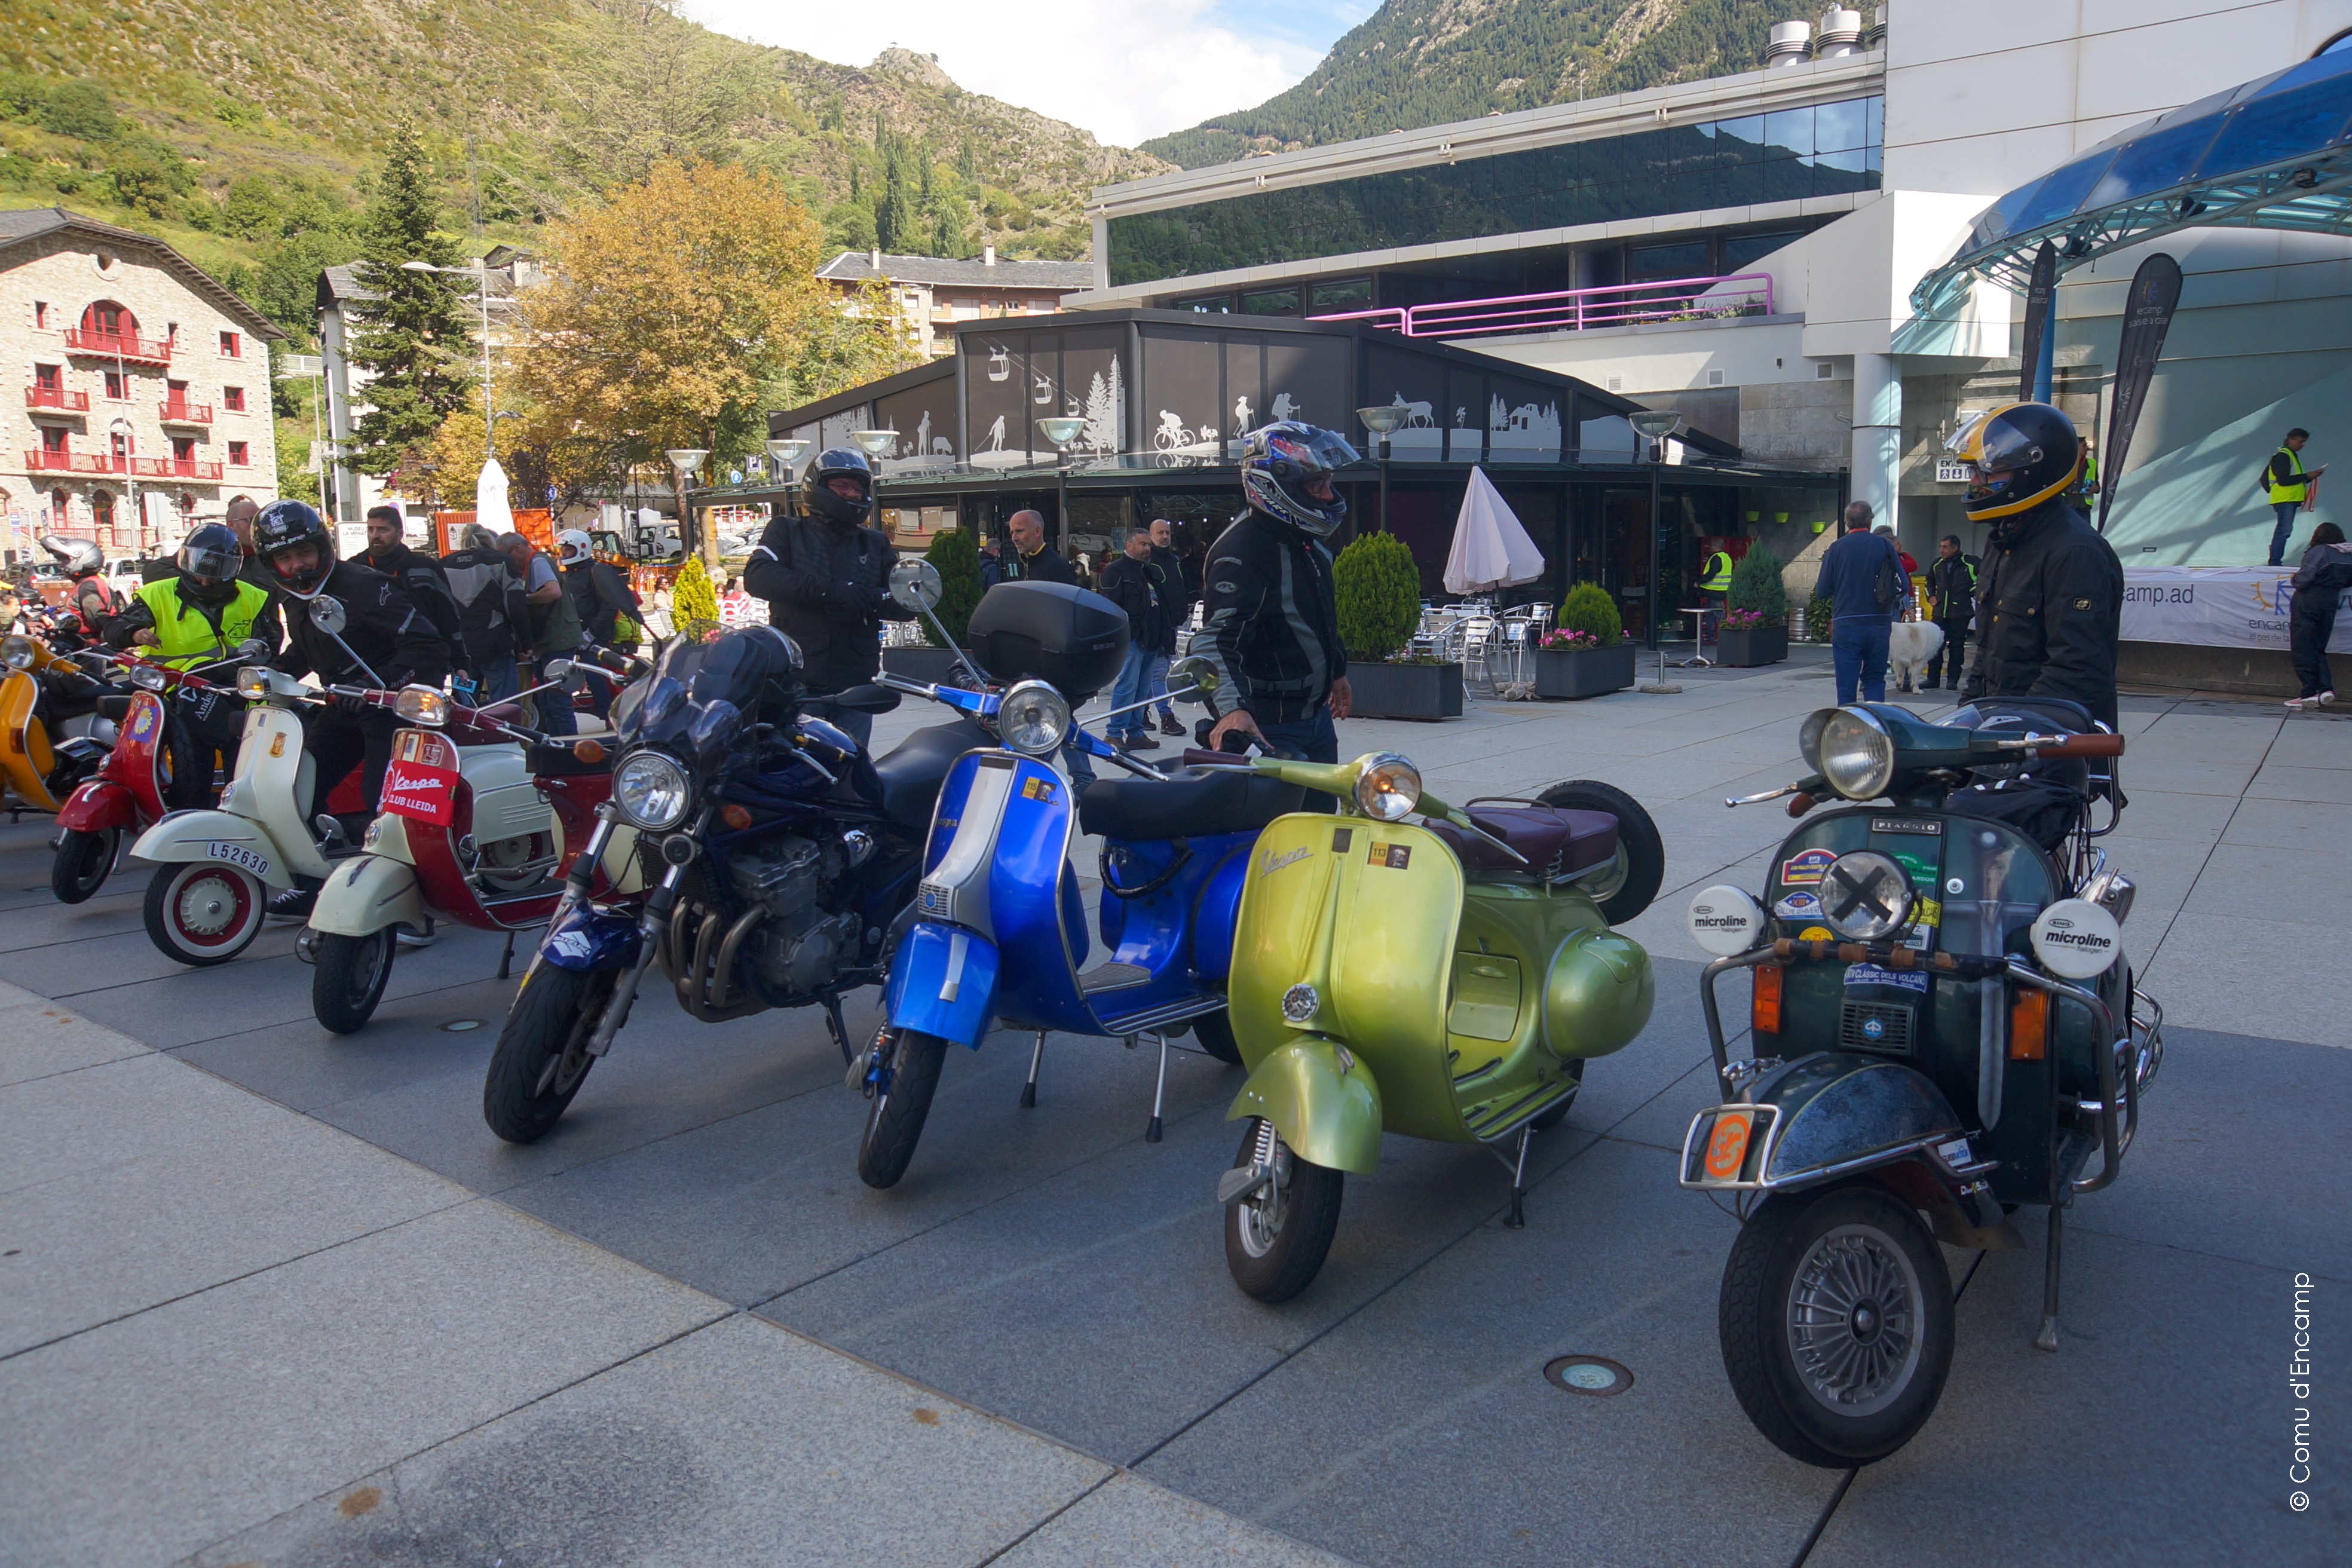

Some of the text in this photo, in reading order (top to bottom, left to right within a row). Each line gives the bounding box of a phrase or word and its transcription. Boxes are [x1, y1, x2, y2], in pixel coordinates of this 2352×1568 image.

[2258, 634, 2270, 642] pas
[393, 768, 443, 791] Vespa
[1026, 782, 1037, 791] 115
[388, 794, 437, 814] CLUB LLEIDA
[1878, 822, 1936, 831] PIAGGIO
[210, 843, 268, 874] L52630
[1373, 847, 1386, 858] 113
[1260, 846, 1314, 879] Vespa
[1695, 915, 1747, 927] microline
[553, 936, 590, 955] SUZUKI
[2045, 930, 2111, 948] microline
[2077, 945, 2102, 955] halogen
[1881, 972, 1897, 980] DELS
[1898, 974, 1926, 985] VOLCANS
